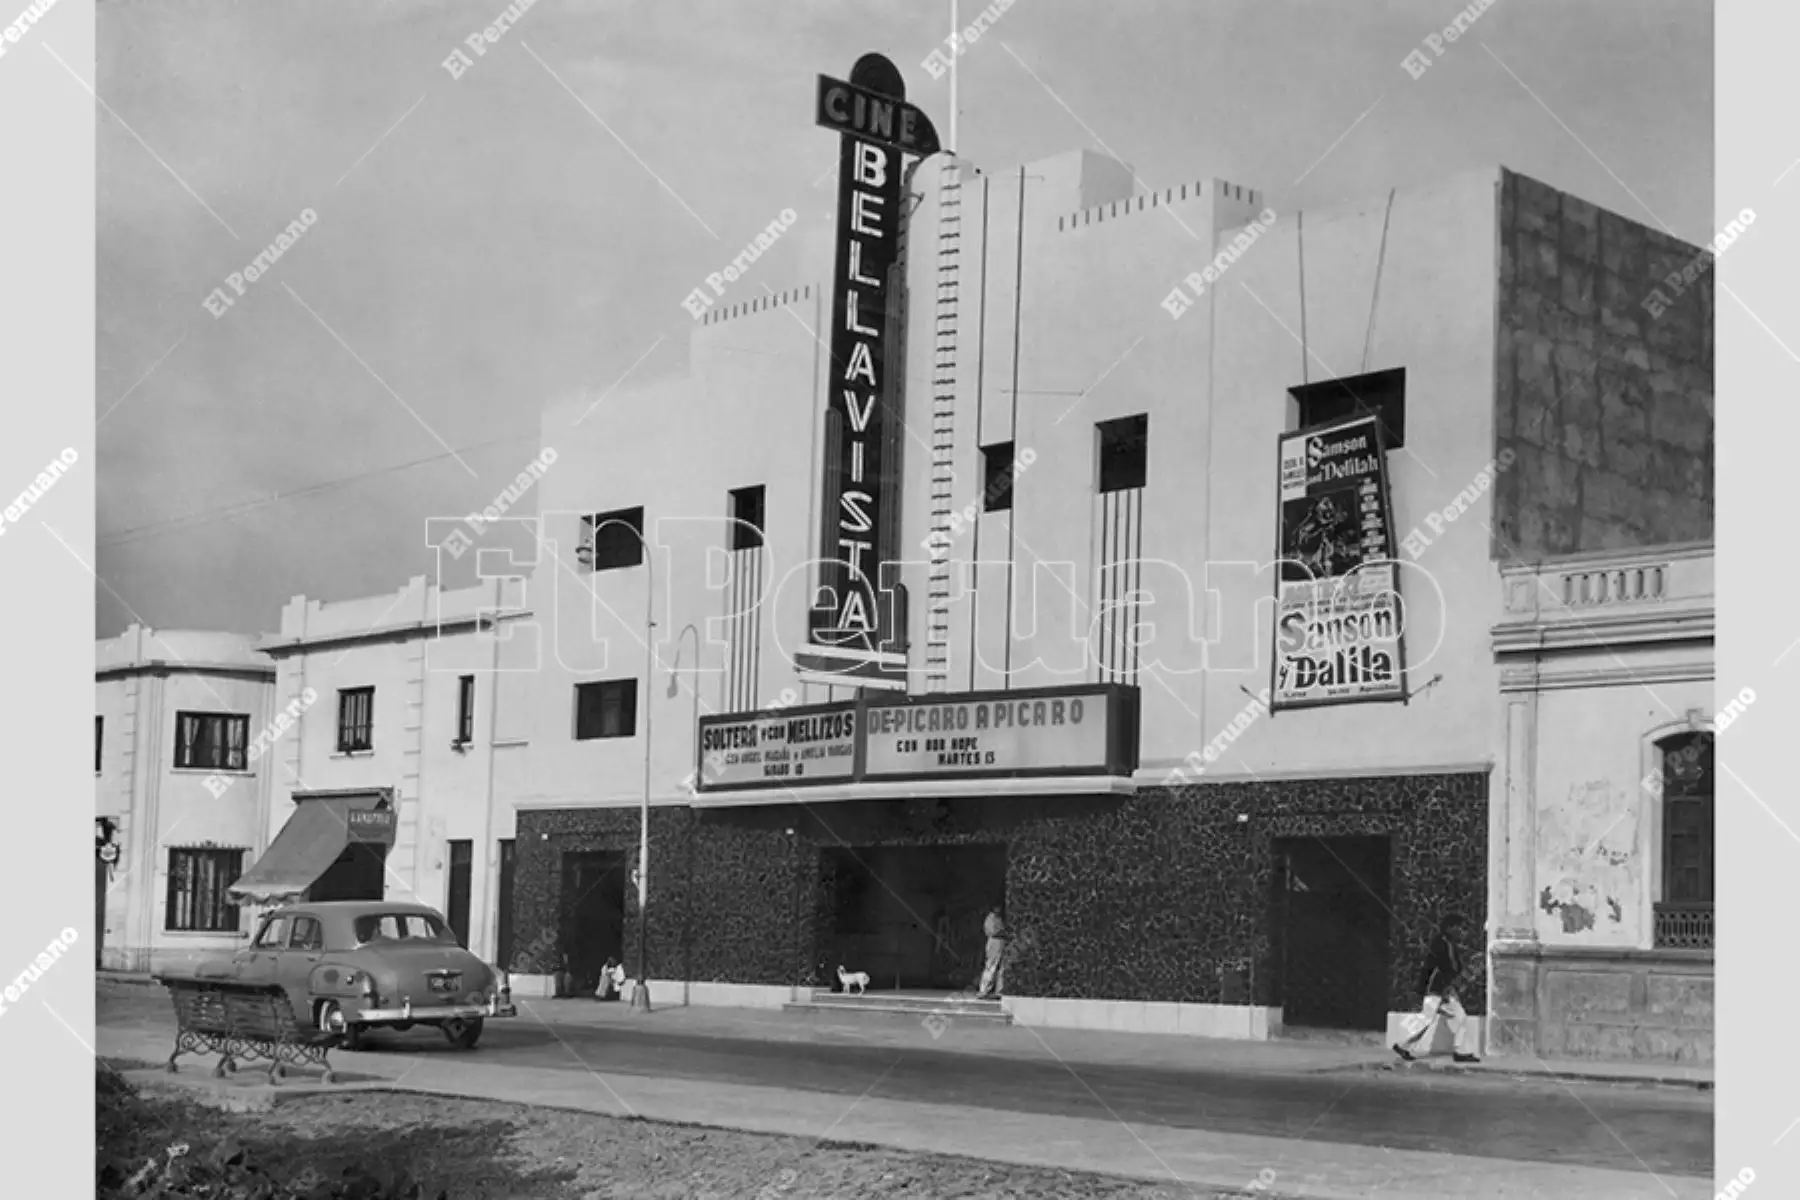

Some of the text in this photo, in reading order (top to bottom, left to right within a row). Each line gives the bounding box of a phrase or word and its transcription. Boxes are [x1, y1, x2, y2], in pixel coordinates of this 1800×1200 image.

[825, 87, 917, 143] CINE
[838, 140, 888, 632] BELLAVISTA
[1308, 437, 1367, 468] Samson
[1320, 454, 1379, 480] Delilah
[1281, 610, 1393, 653] Sanson
[1286, 645, 1392, 688] Dalila
[975, 704, 989, 730] A
[994, 699, 1084, 728] PICARO
[704, 723, 757, 751] SOLTERA
[787, 713, 853, 744] MELLIZOS
[896, 739, 918, 752] CON
[938, 751, 980, 765] MARTES
